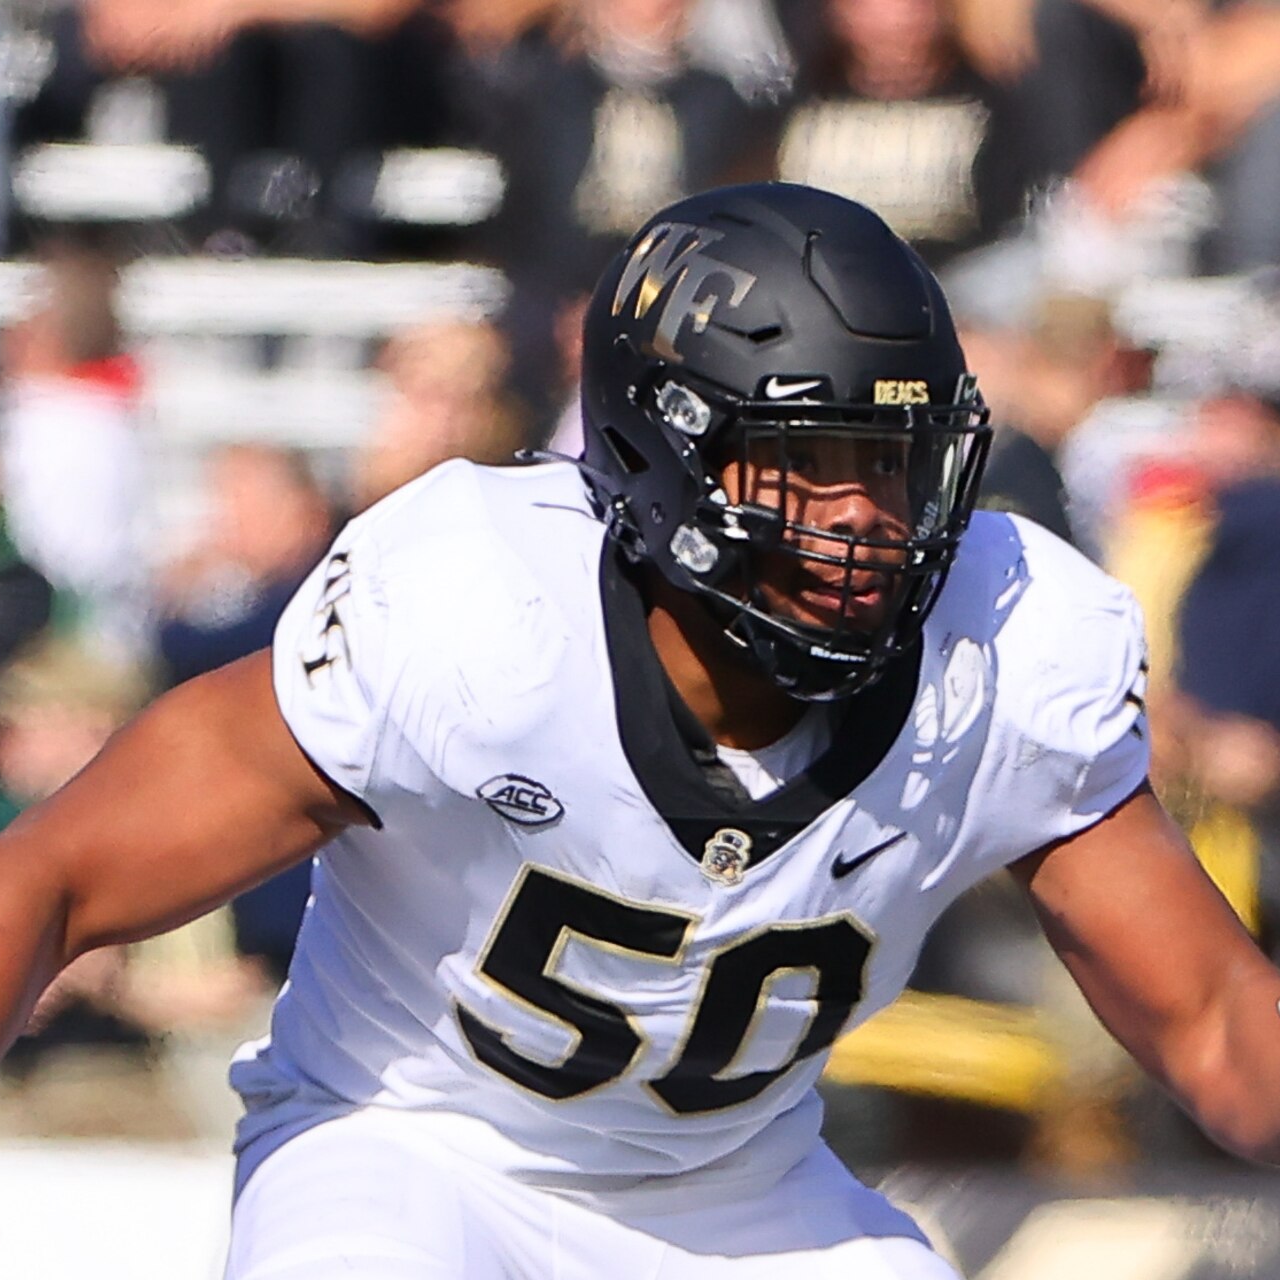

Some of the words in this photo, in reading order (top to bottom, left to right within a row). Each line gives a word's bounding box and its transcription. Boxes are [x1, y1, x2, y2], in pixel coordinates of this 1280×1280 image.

[612, 222, 757, 364] WF
[874, 380, 930, 405] DEACS
[490, 785, 553, 813] ACC
[450, 862, 878, 1118] 50
